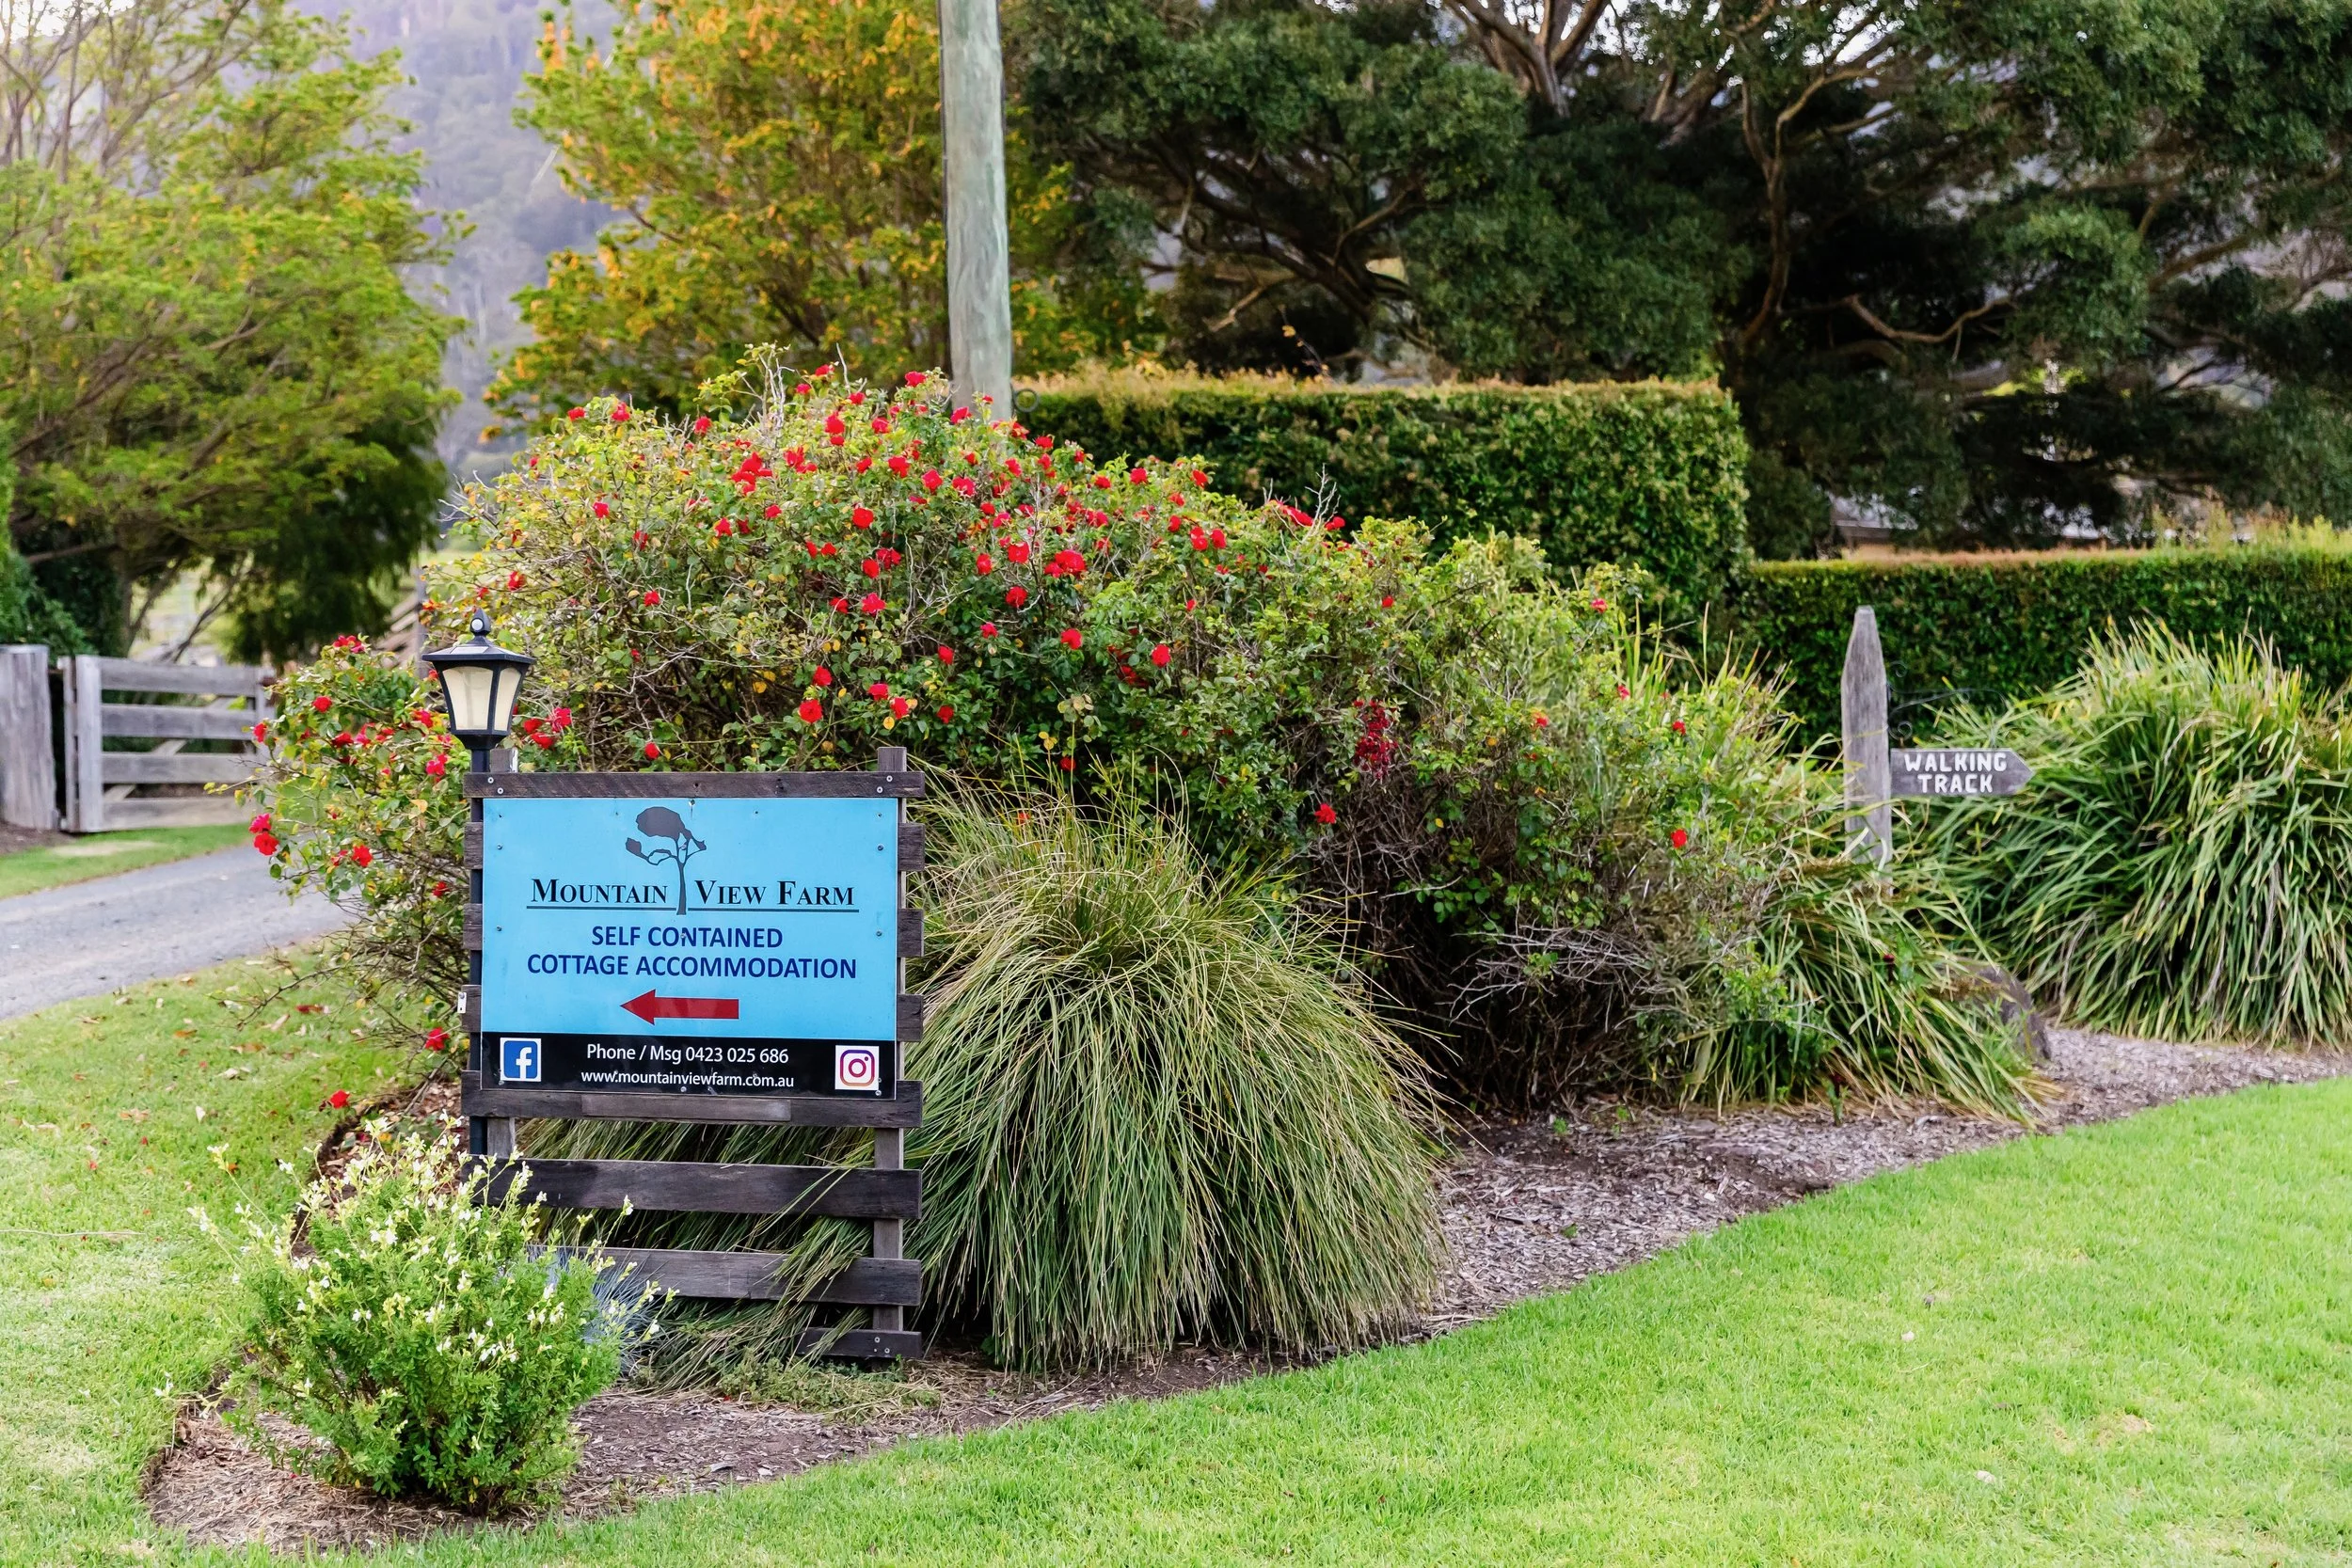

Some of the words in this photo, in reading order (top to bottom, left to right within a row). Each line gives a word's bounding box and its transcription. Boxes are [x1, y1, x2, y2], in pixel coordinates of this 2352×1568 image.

[1903, 752, 2008, 772] WALKING
[1917, 773, 1994, 794] TRACK
[531, 878, 669, 904] MOUNTAIN
[693, 879, 768, 905] VIEW
[777, 880, 855, 906] FARM
[592, 926, 641, 946] SELF
[647, 927, 784, 948] CONTAINED
[527, 954, 629, 975] COTTAGE
[635, 957, 857, 979] ACCOMMODATION
[586, 1043, 636, 1060] Phone
[639, 1044, 647, 1061] /
[649, 1045, 682, 1065] Msg
[685, 1046, 723, 1063] 0423
[726, 1047, 756, 1063] 025
[759, 1048, 789, 1064] 686
[580, 1070, 794, 1088] www.mountainviewfarm.com.au
